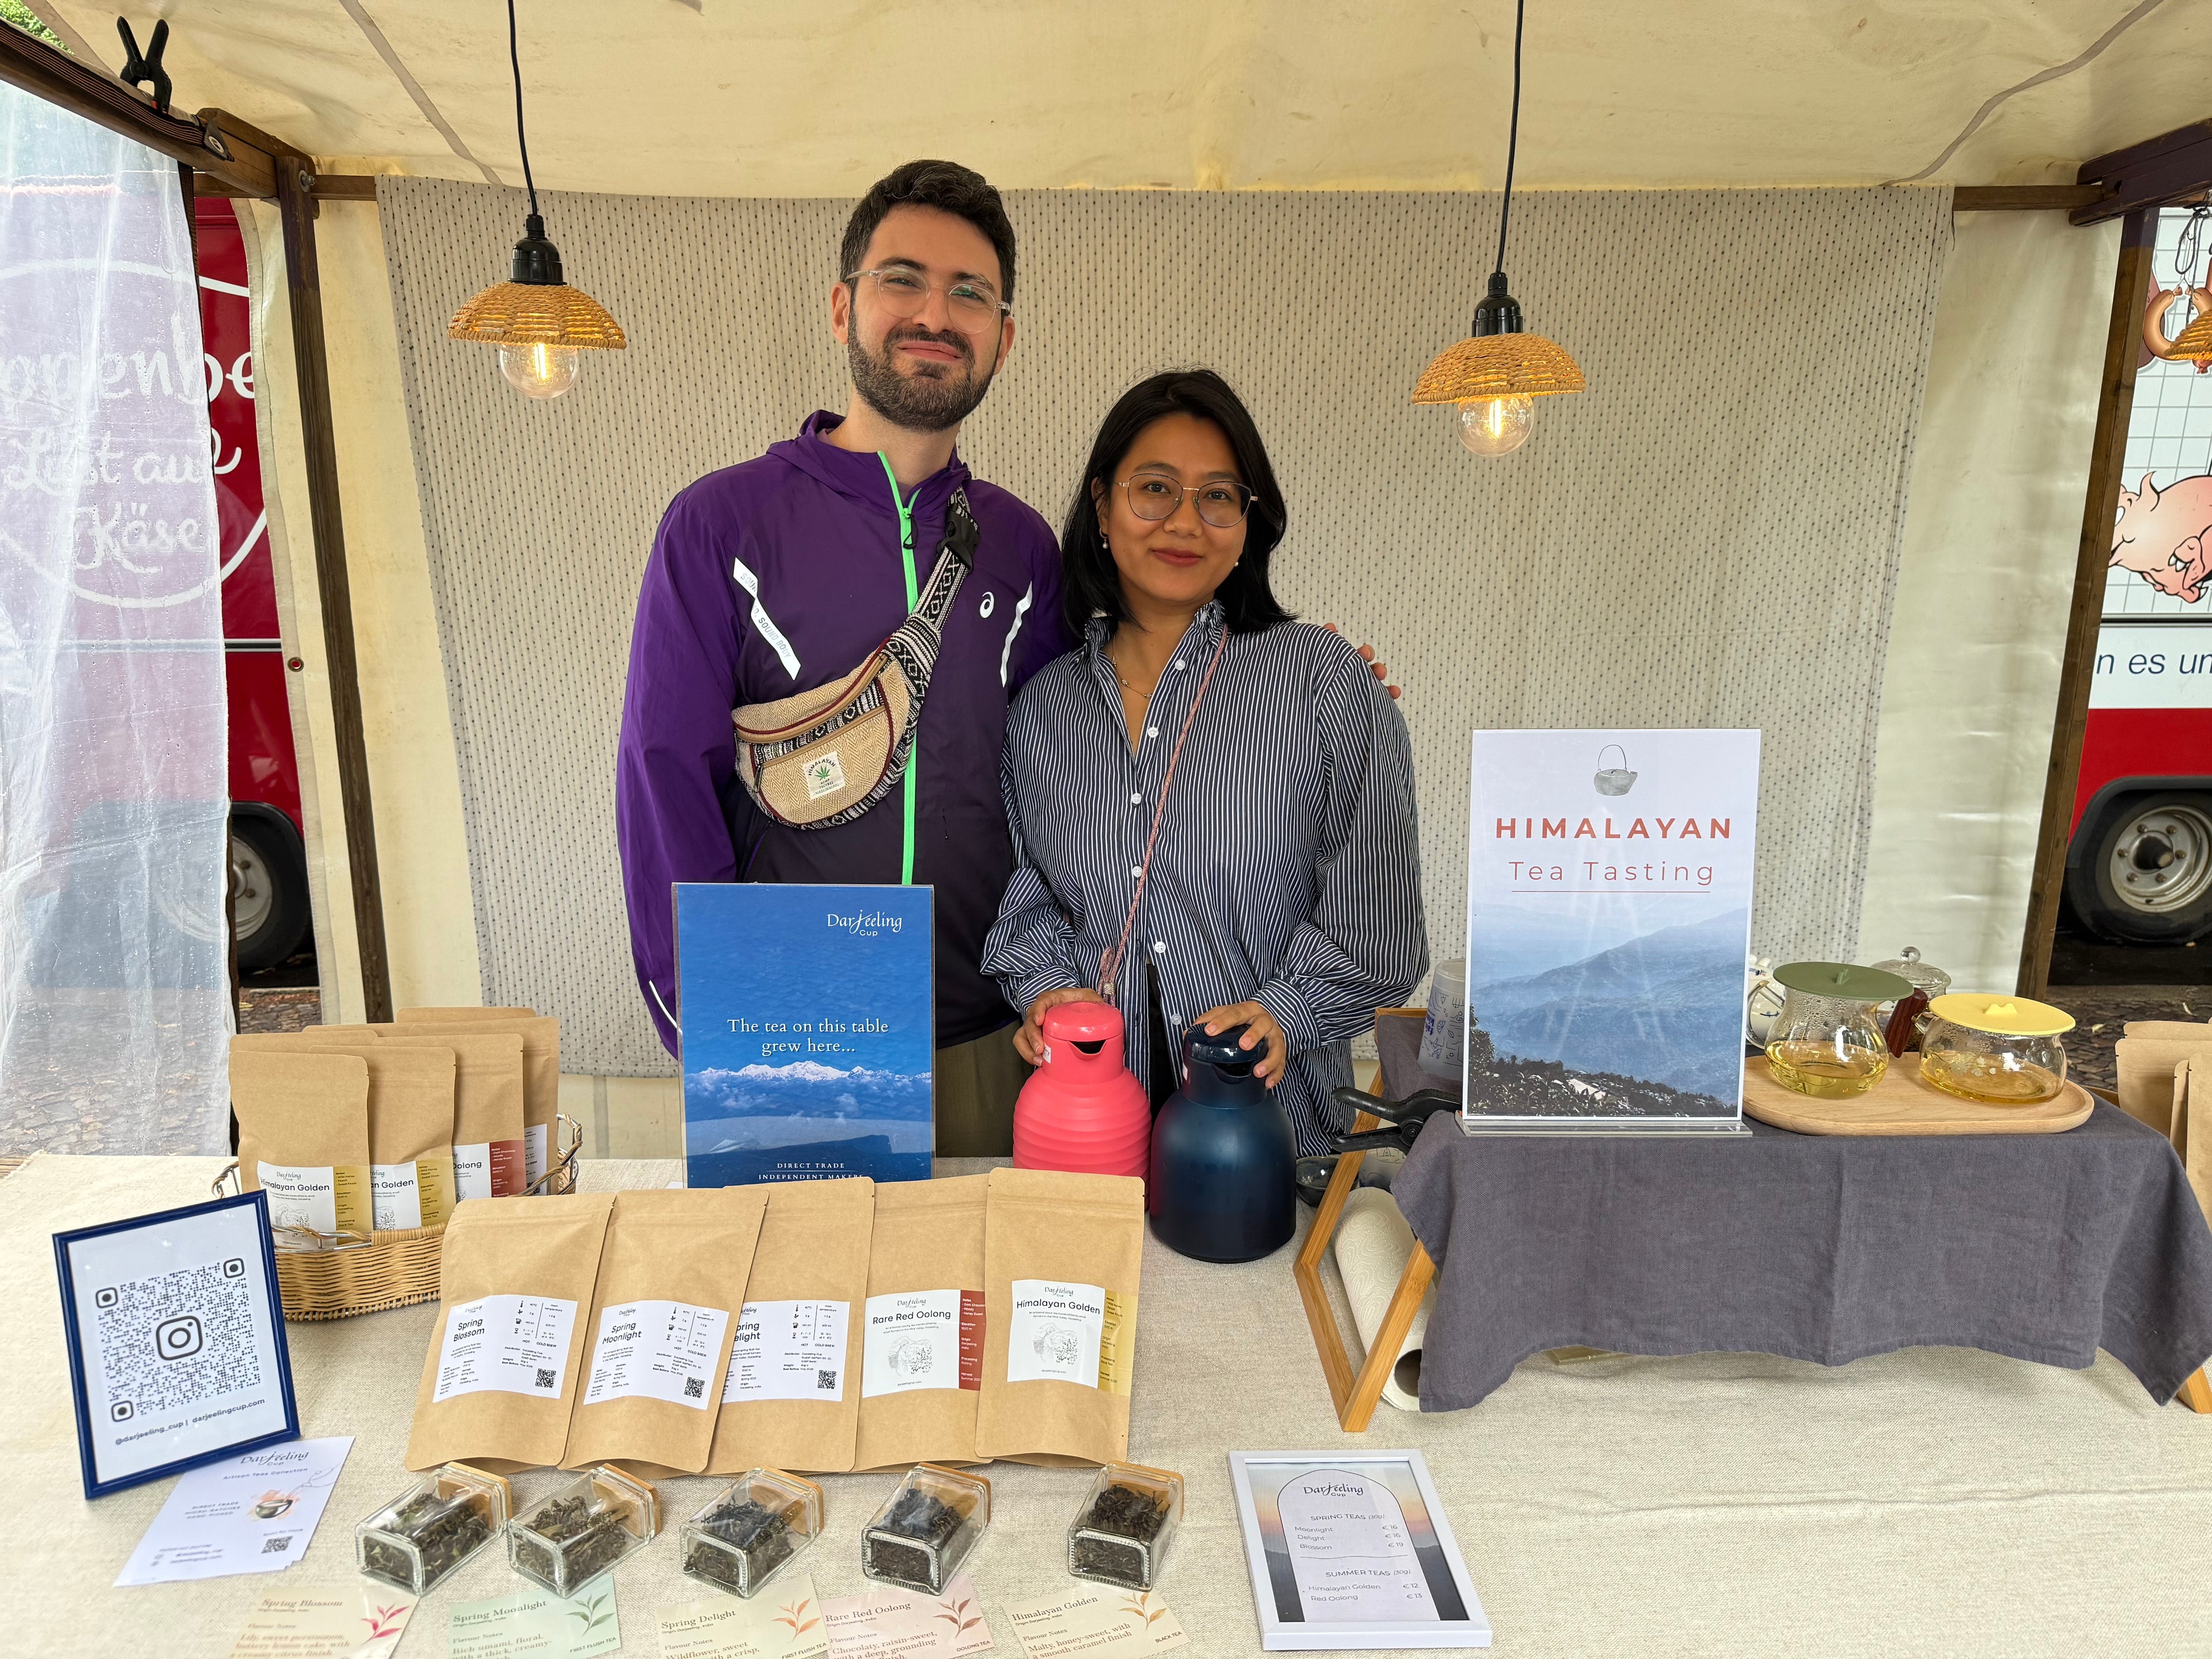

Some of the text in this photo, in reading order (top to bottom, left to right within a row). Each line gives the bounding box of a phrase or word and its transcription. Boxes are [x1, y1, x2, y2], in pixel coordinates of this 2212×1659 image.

[72, 500, 203, 573] Käse
[759, 618, 791, 658] SOUND BODY
[2128, 654, 2166, 675] es
[808, 758, 836, 776] HIMALAYAN
[1496, 818, 1731, 839] HIMALAYAN
[1509, 861, 1714, 886] Tea Tasting
[827, 909, 903, 934] Darjeeling
[859, 929, 878, 937] Cup
[727, 1017, 889, 1033] The tea on this table
[762, 1037, 855, 1056] grew here...
[260, 1178, 295, 1191] Himalayan
[382, 1180, 414, 1188] Golden
[1044, 1286, 1074, 1296] Darjeeling
[897, 1297, 926, 1308] Darjeeling
[1017, 1298, 1100, 1315] Himalayan Golden
[458, 1318, 483, 1331] Spring
[873, 1310, 951, 1324] Rare Red Oolong
[453, 1327, 484, 1342] Blossom
[611, 1322, 637, 1333] Spring
[736, 1322, 760, 1332] pring
[603, 1330, 642, 1344] Moonlight
[734, 1332, 760, 1342] elight
[116, 1421, 184, 1445] @darjeeling_cup
[192, 1399, 265, 1423] darjeelingcup.com
[240, 1451, 309, 1465] Darjeeling
[1304, 1482, 1363, 1497] Darjeeling
[453, 1600, 547, 1623] Spring Moonlight
[825, 1602, 911, 1622] Rare Red Oolong
[1012, 1596, 1099, 1622] Himalayan Golden
[661, 1610, 736, 1630] Spring Delight
[453, 1635, 480, 1643] Flavour
[832, 1631, 937, 1654] Chocolaty, raisin-sweet,
[1023, 1634, 1048, 1642] Flavour
[1028, 1622, 1131, 1653] Malty, honey-sweet, with
[1039, 1647, 1071, 1658] smooth
[1073, 1638, 1107, 1651] caramel
[1107, 1630, 1132, 1642] finish
[1154, 1635, 1172, 1643] BLACK
[570, 1645, 586, 1653] FIRST
[586, 1641, 605, 1649] FLUSH
[666, 1642, 748, 1659] Wildflower, sweet
[798, 1647, 815, 1656] FLUSH
[891, 1639, 937, 1654] grounding
